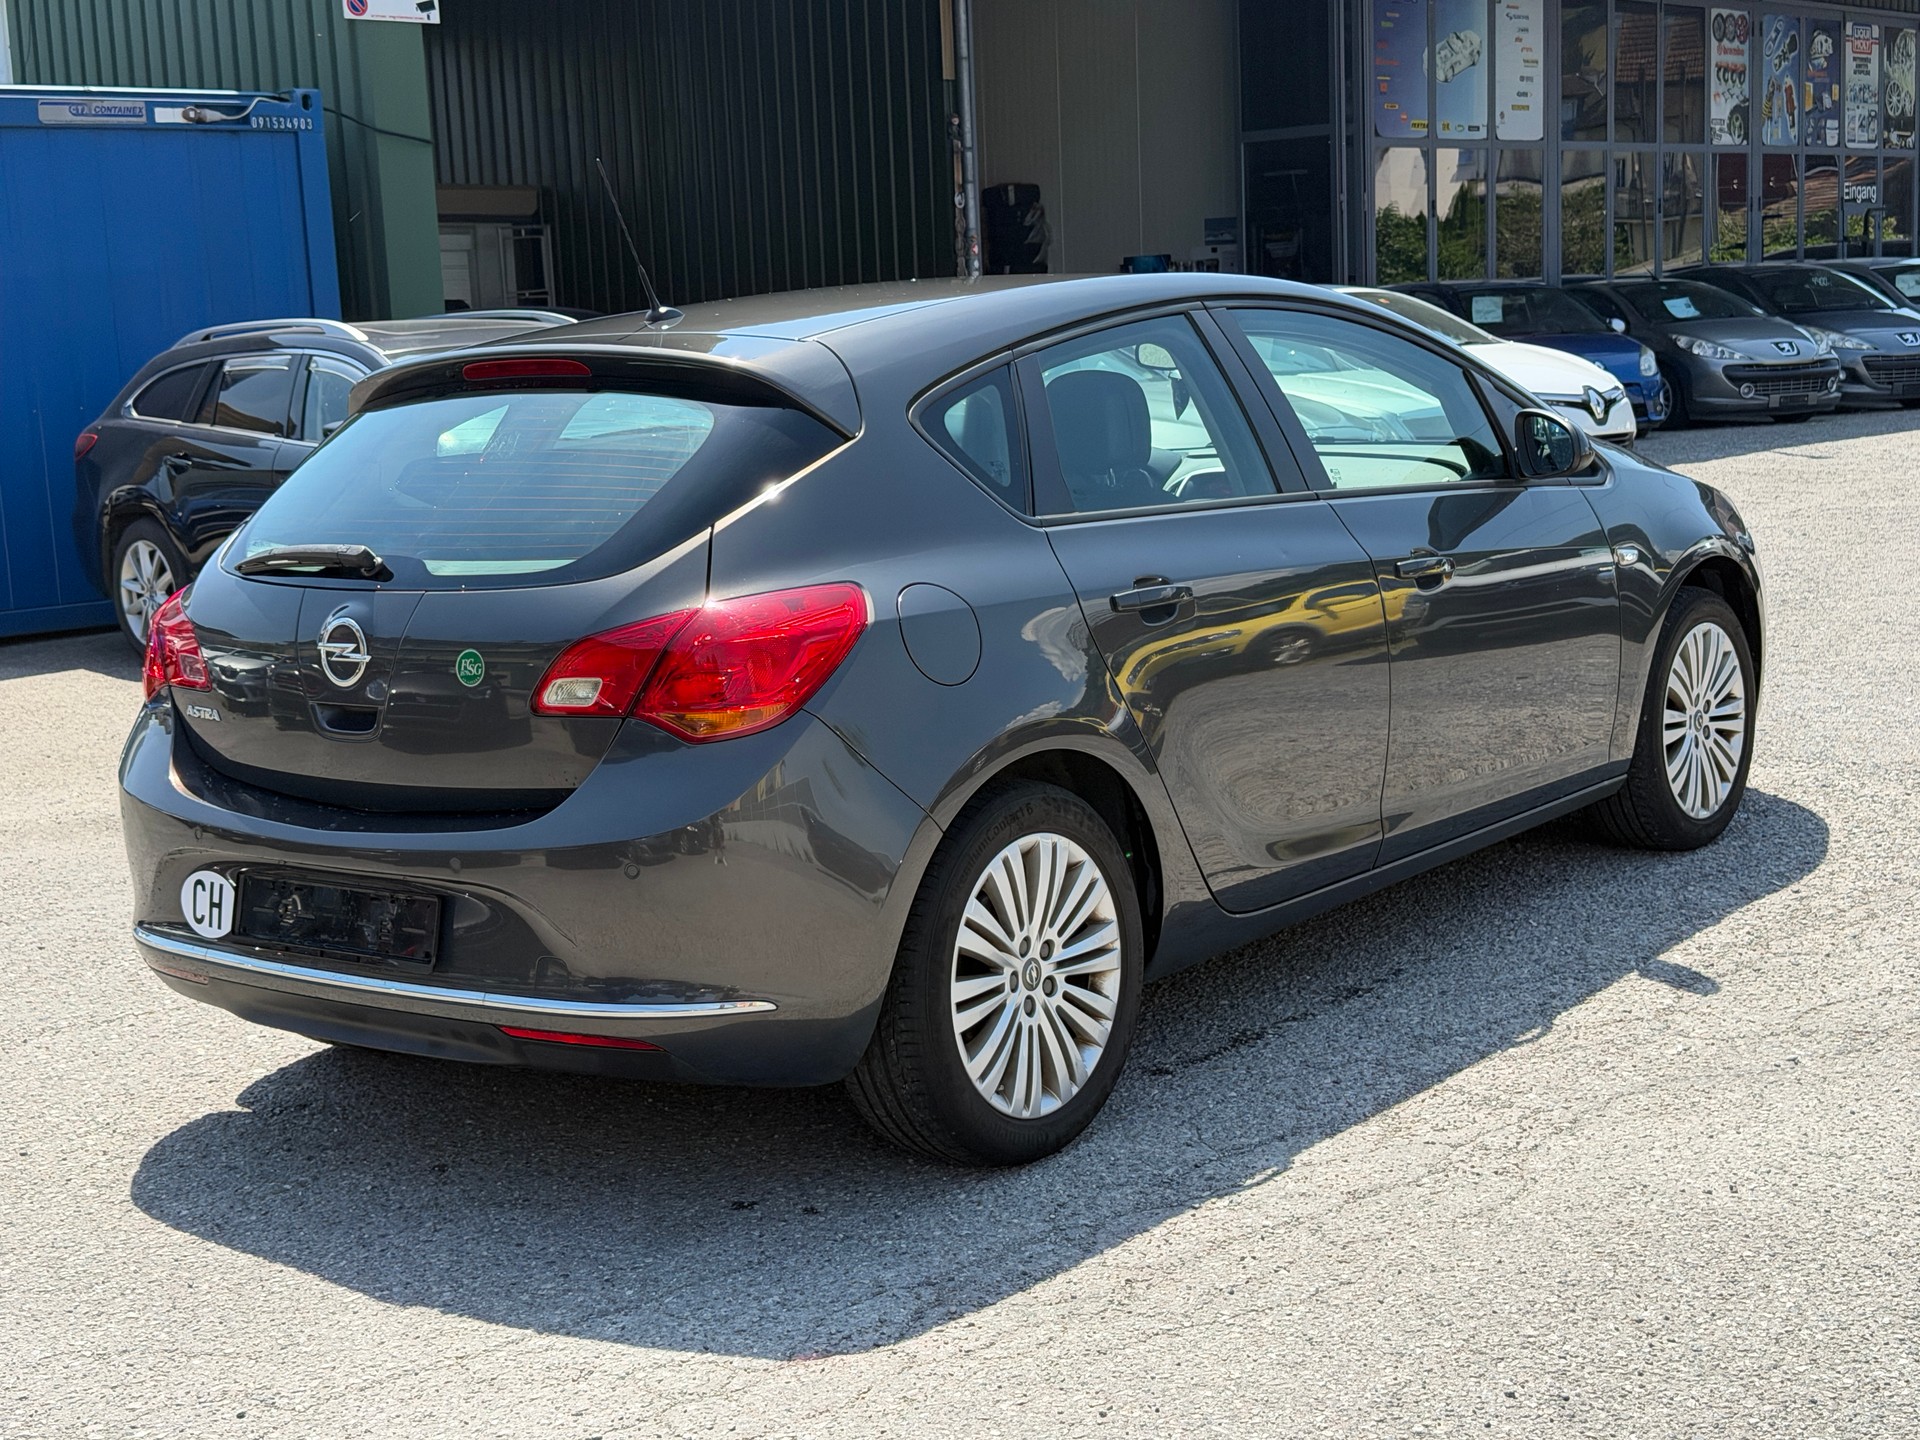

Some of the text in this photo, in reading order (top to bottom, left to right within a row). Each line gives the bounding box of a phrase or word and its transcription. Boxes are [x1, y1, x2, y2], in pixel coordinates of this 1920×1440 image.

[93, 105, 144, 115] CONTAINEX
[251, 116, 313, 130] 091534903
[1843, 182, 1877, 203] Eingang
[187, 704, 221, 721] ASTRA
[192, 878, 224, 931] CH
